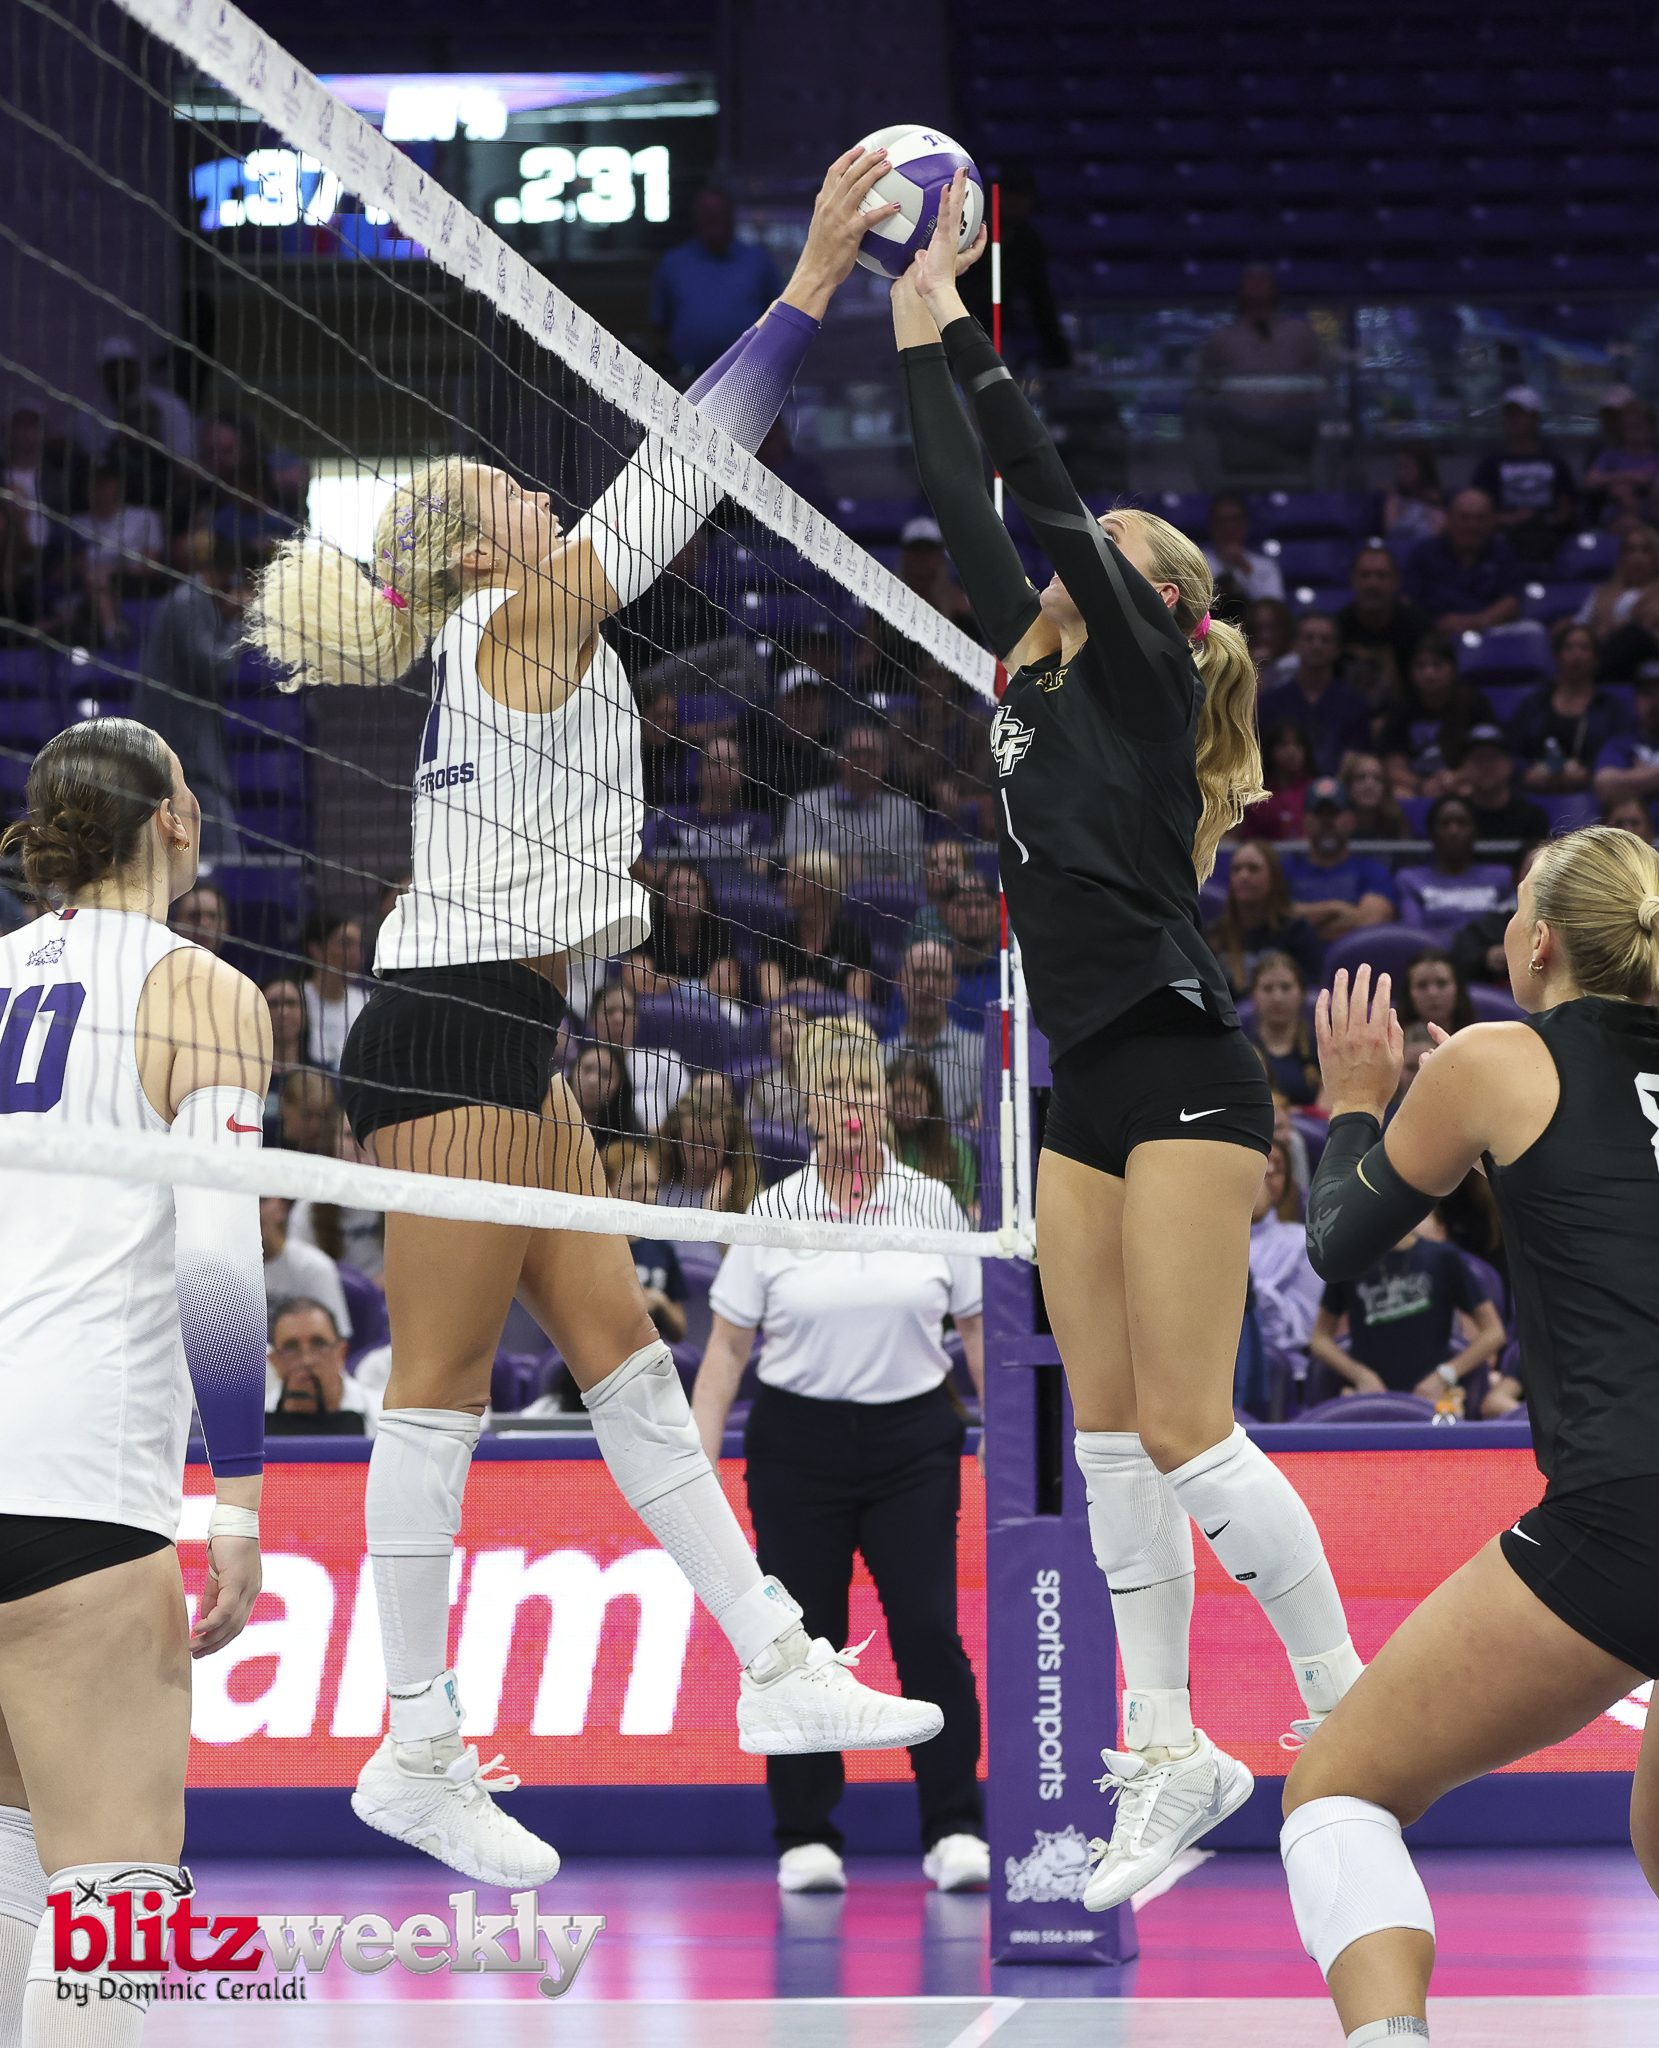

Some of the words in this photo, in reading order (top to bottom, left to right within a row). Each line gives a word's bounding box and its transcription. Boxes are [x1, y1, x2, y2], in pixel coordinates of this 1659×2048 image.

[219, 148, 390, 226] .37
[495, 145, 671, 224] .231
[420, 762, 475, 796] FROGS
[181, 1494, 696, 1746] arm
[1031, 1569, 1066, 1672] sports
